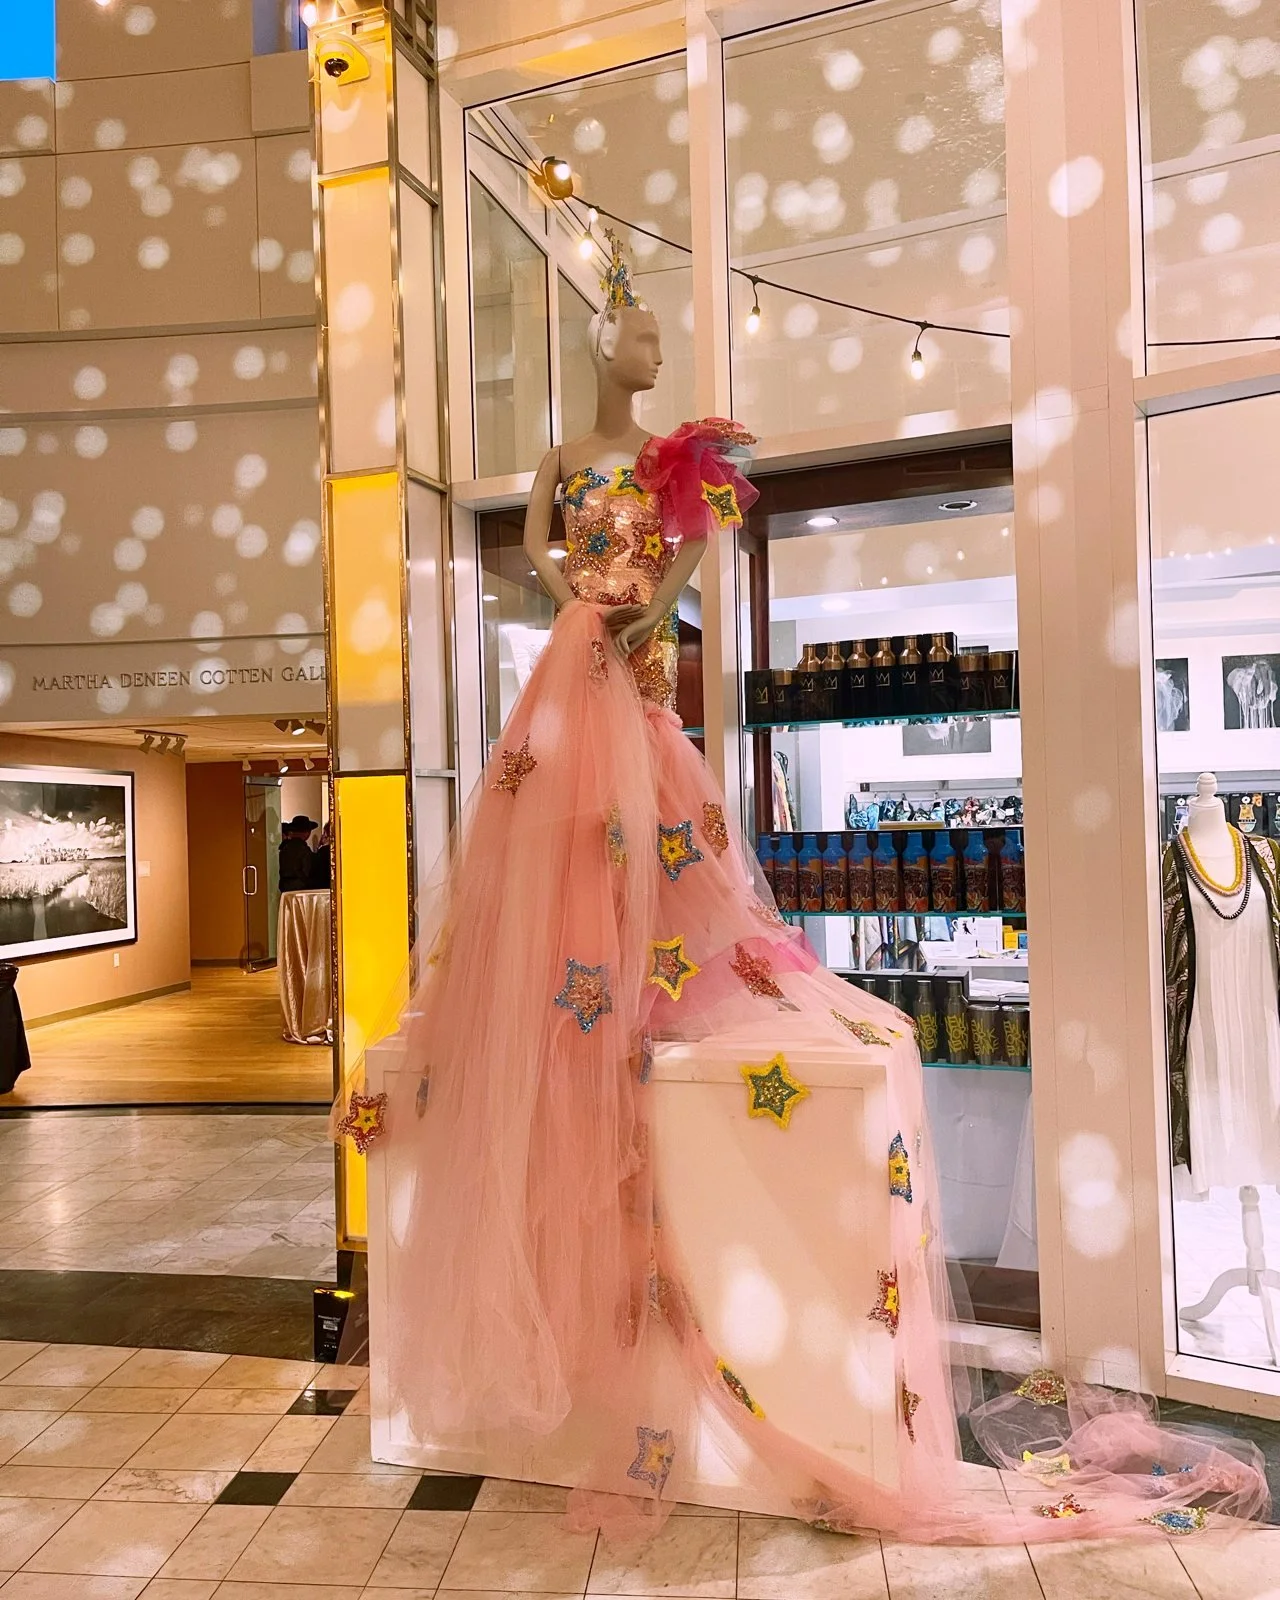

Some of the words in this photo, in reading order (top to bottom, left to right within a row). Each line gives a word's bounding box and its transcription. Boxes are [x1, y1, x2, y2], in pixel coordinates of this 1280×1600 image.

[32, 674, 114, 692] MARTHA
[120, 671, 191, 689] DENEEN
[200, 668, 274, 685] COTTEN
